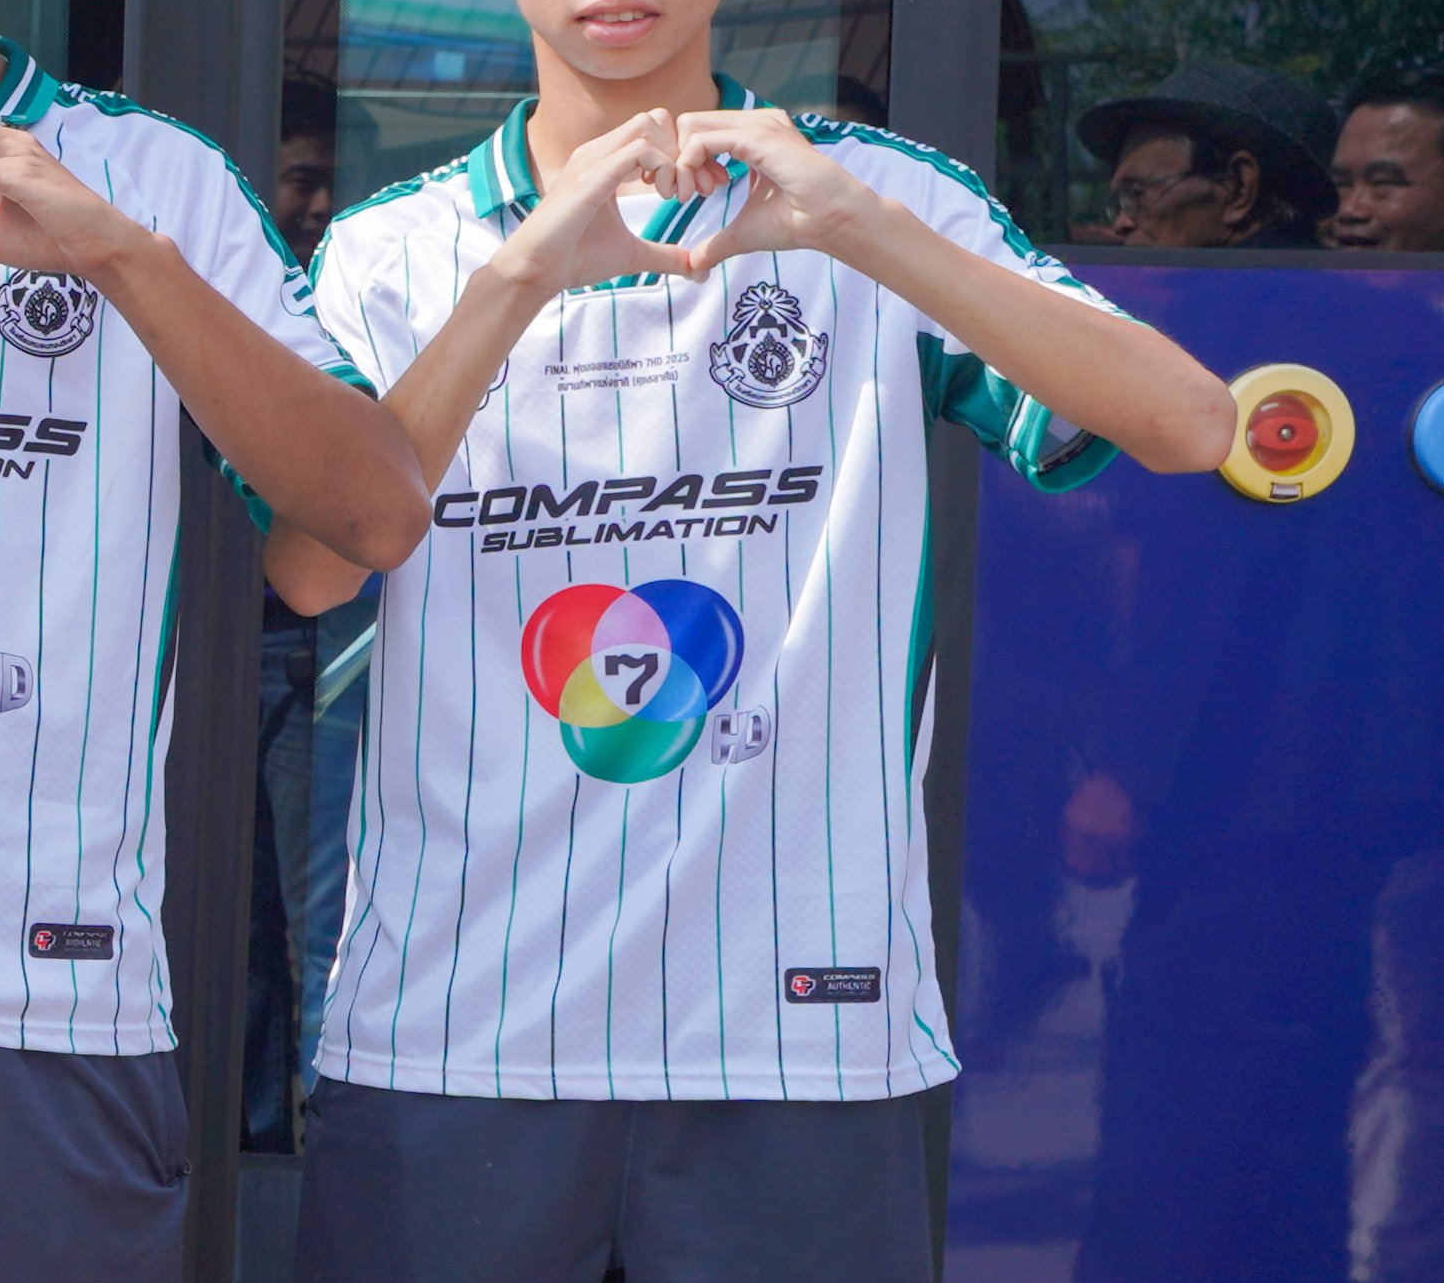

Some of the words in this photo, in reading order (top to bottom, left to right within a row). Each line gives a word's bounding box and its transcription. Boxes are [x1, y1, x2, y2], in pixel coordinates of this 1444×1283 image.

[544, 364, 570, 376] FINAL
[646, 357, 663, 368] 7HD
[666, 352, 690, 365] 2025
[433, 465, 824, 529] COMPASS
[480, 513, 779, 554] SUBLIMATION
[603, 651, 659, 705] 7
[710, 702, 772, 767] HD
